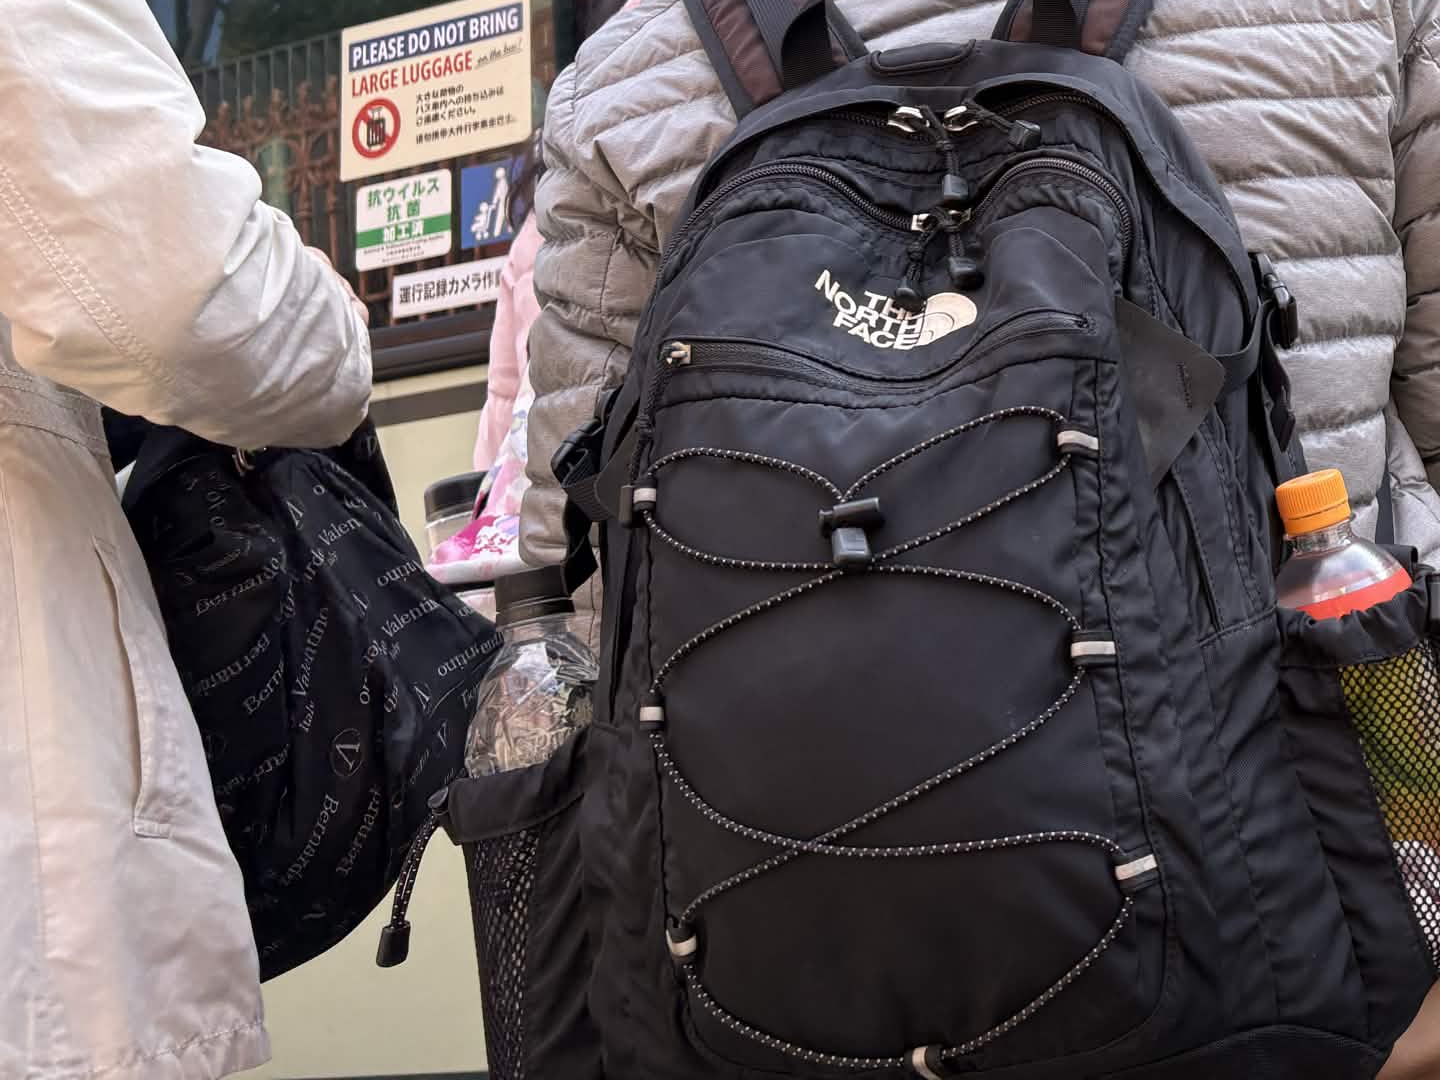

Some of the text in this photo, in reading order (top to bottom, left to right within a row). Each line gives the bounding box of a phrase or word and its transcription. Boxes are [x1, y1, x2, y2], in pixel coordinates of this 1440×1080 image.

[352, 7, 519, 69] PLEASE DO NOT BRING
[352, 68, 398, 98] LARGE
[402, 50, 473, 87] LUGGAGE
[367, 177, 439, 209] 抗ウイルス
[815, 270, 922, 335] NORTH
[832, 311, 921, 350] FACE
